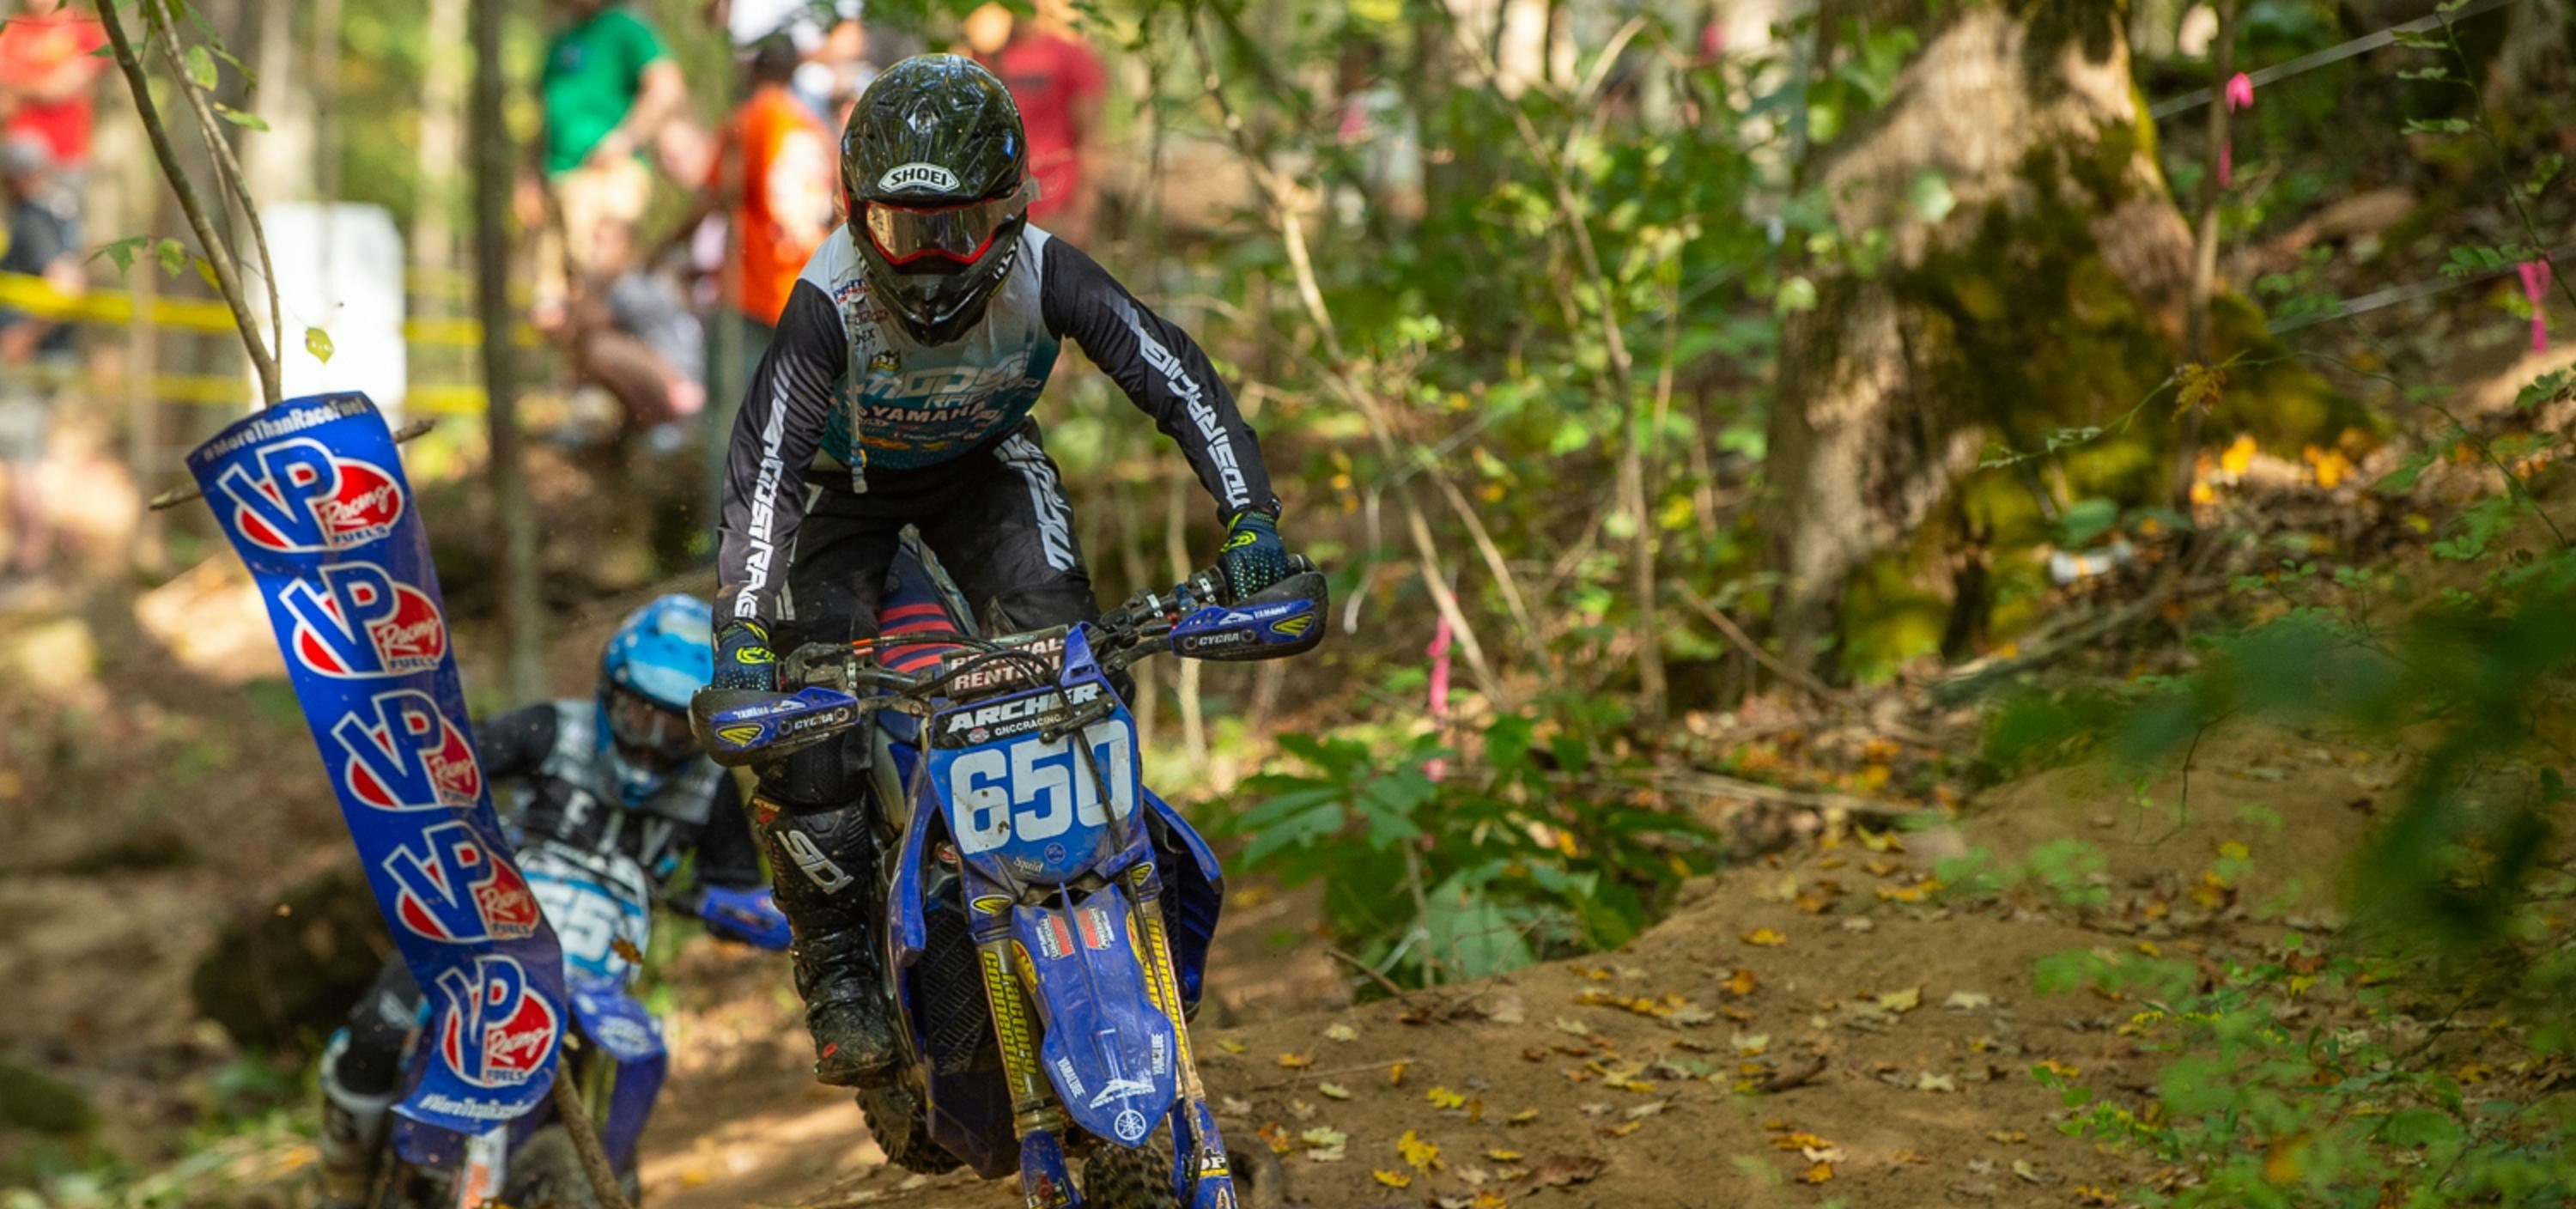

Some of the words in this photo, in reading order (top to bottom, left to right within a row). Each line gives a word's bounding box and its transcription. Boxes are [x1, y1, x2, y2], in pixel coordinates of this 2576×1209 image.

[890, 168, 950, 186] SHOEI
[217, 437, 342, 553] VP
[319, 483, 396, 528] Racing
[331, 525, 389, 547] FUELS
[278, 561, 401, 679] VP
[376, 616, 440, 653] Racing
[388, 655, 440, 671] FUELS
[1199, 632, 1240, 647] CYCRA
[1253, 605, 1288, 620] YAMAHA
[331, 689, 446, 812] VP
[950, 720, 1134, 855] 650
[382, 819, 498, 944] VP
[490, 921, 533, 938] FUELS
[435, 954, 526, 1085] VP
[488, 1027, 550, 1064] Racing
[982, 950, 1028, 1095] Connection
[1002, 973, 1038, 1074] Factory
[486, 1067, 527, 1082] FUELS
